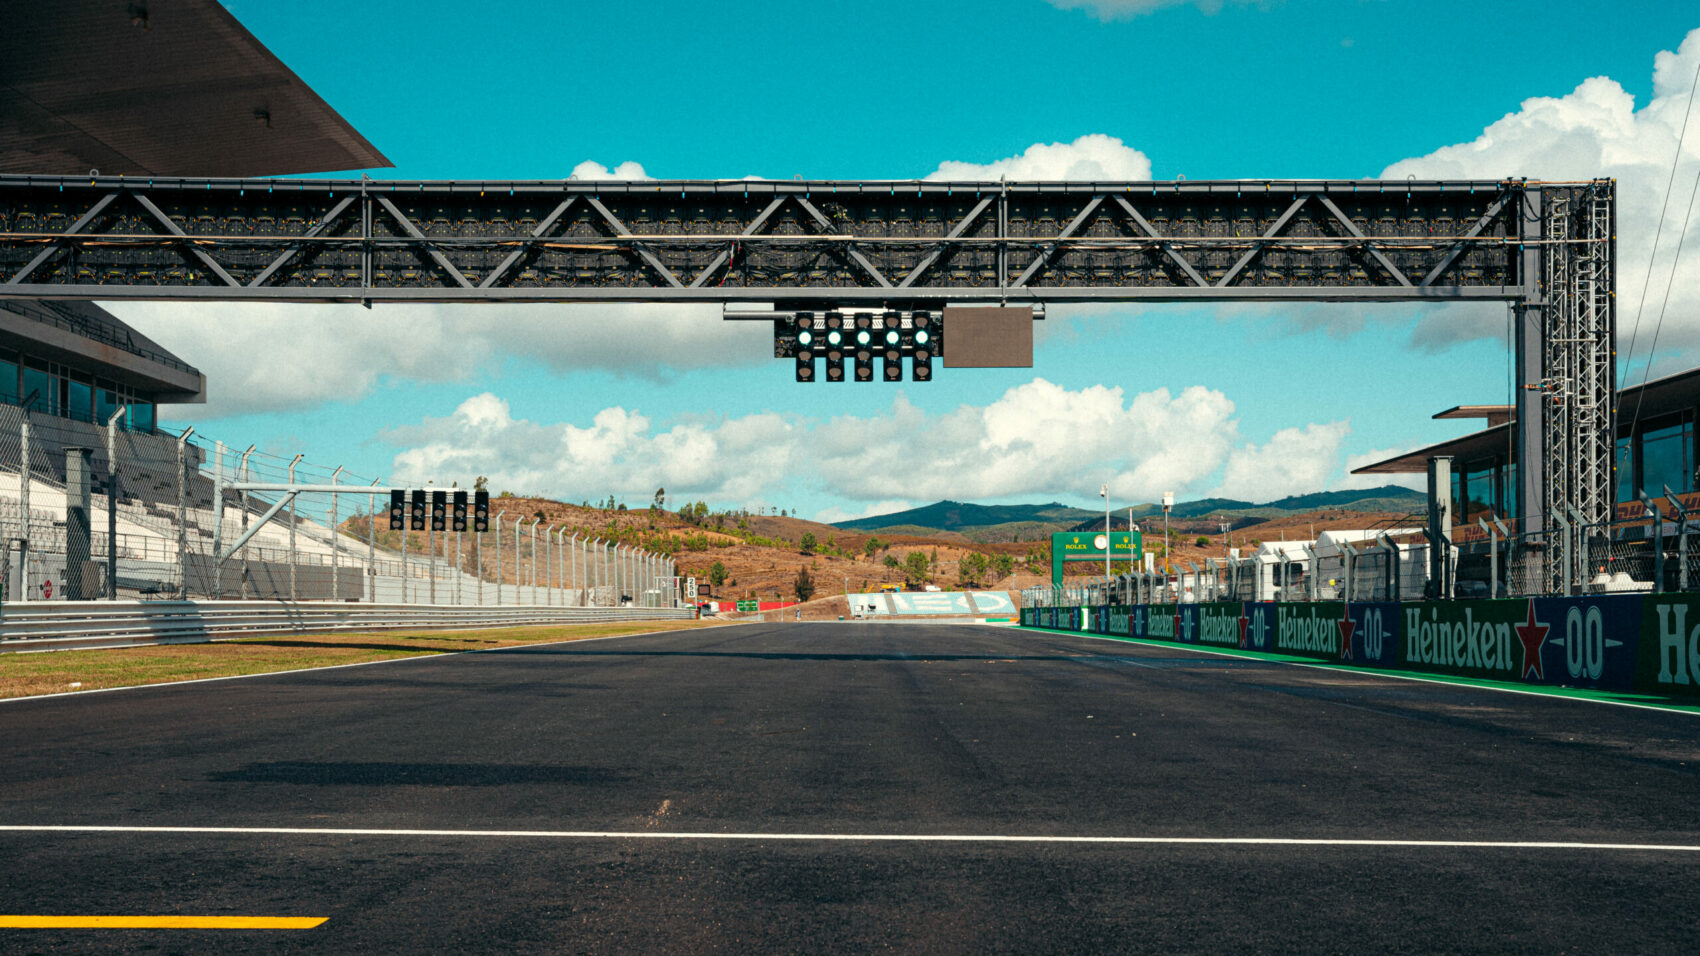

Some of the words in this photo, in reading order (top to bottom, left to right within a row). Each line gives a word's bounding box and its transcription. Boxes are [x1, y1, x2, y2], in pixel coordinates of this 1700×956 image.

[1200, 607, 1237, 643] Heineken
[1278, 606, 1337, 653] Heineken
[1406, 607, 1513, 671] Heineken
[1566, 605, 1603, 680] 0.0
